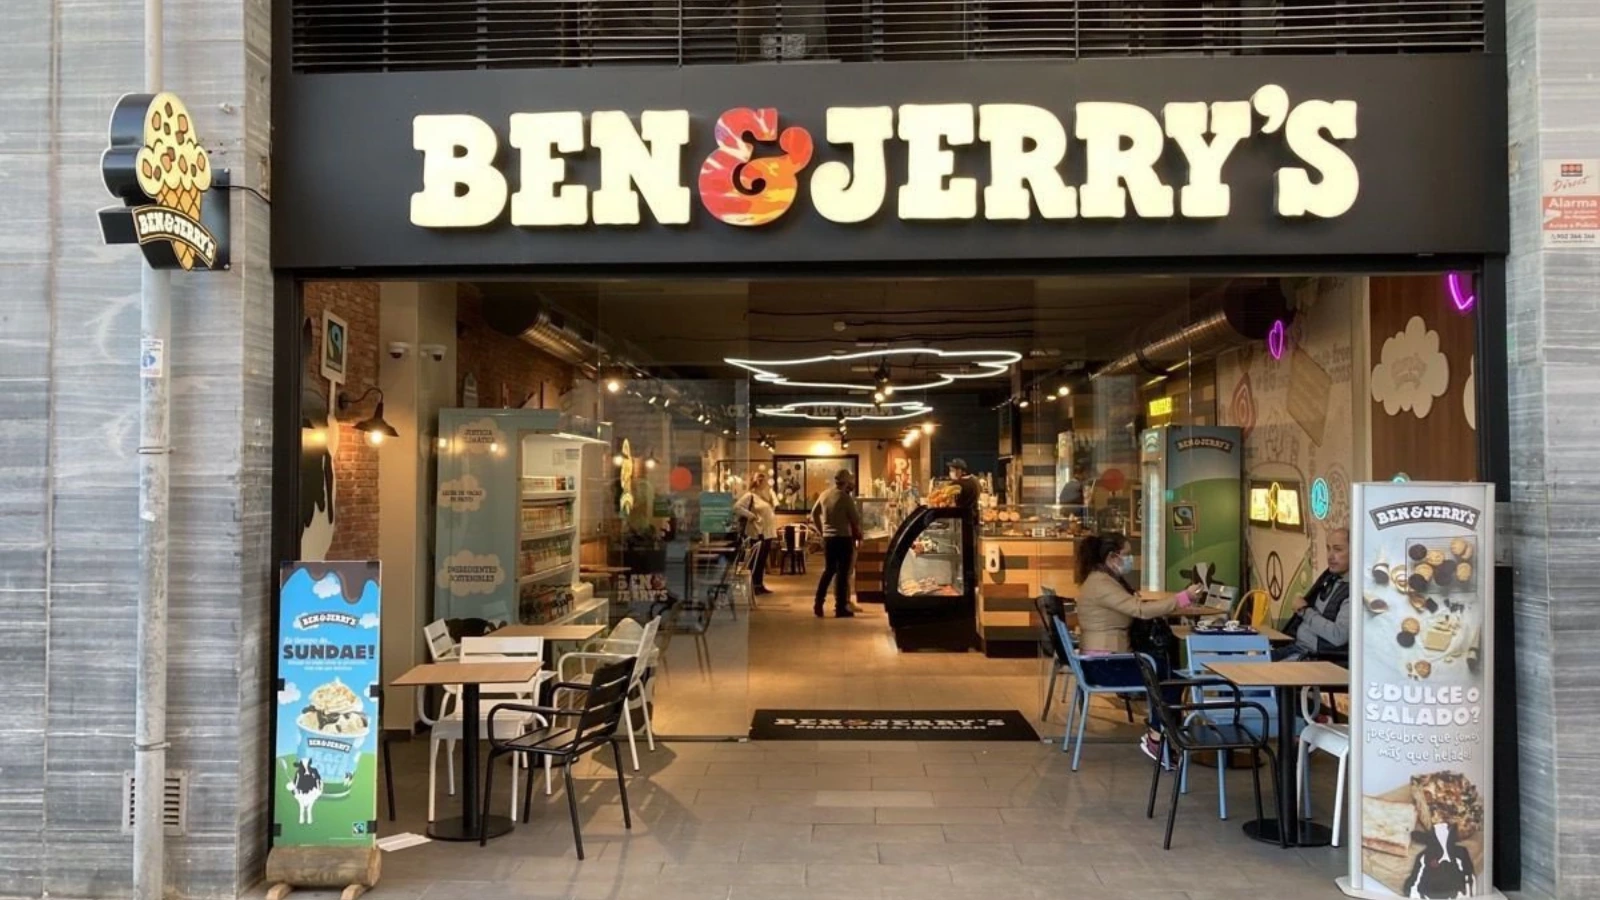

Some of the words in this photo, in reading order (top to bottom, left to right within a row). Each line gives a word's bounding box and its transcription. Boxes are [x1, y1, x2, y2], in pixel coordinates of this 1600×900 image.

[1548, 198, 1598, 208] Alarma
[283, 644, 375, 660] SUNDAE!
[1367, 682, 1462, 704] ¿DULCE
[1467, 686, 1480, 703] O
[1366, 703, 1481, 726] SALADO?
[1429, 733, 1451, 748] que
[1406, 751, 1429, 765] que
